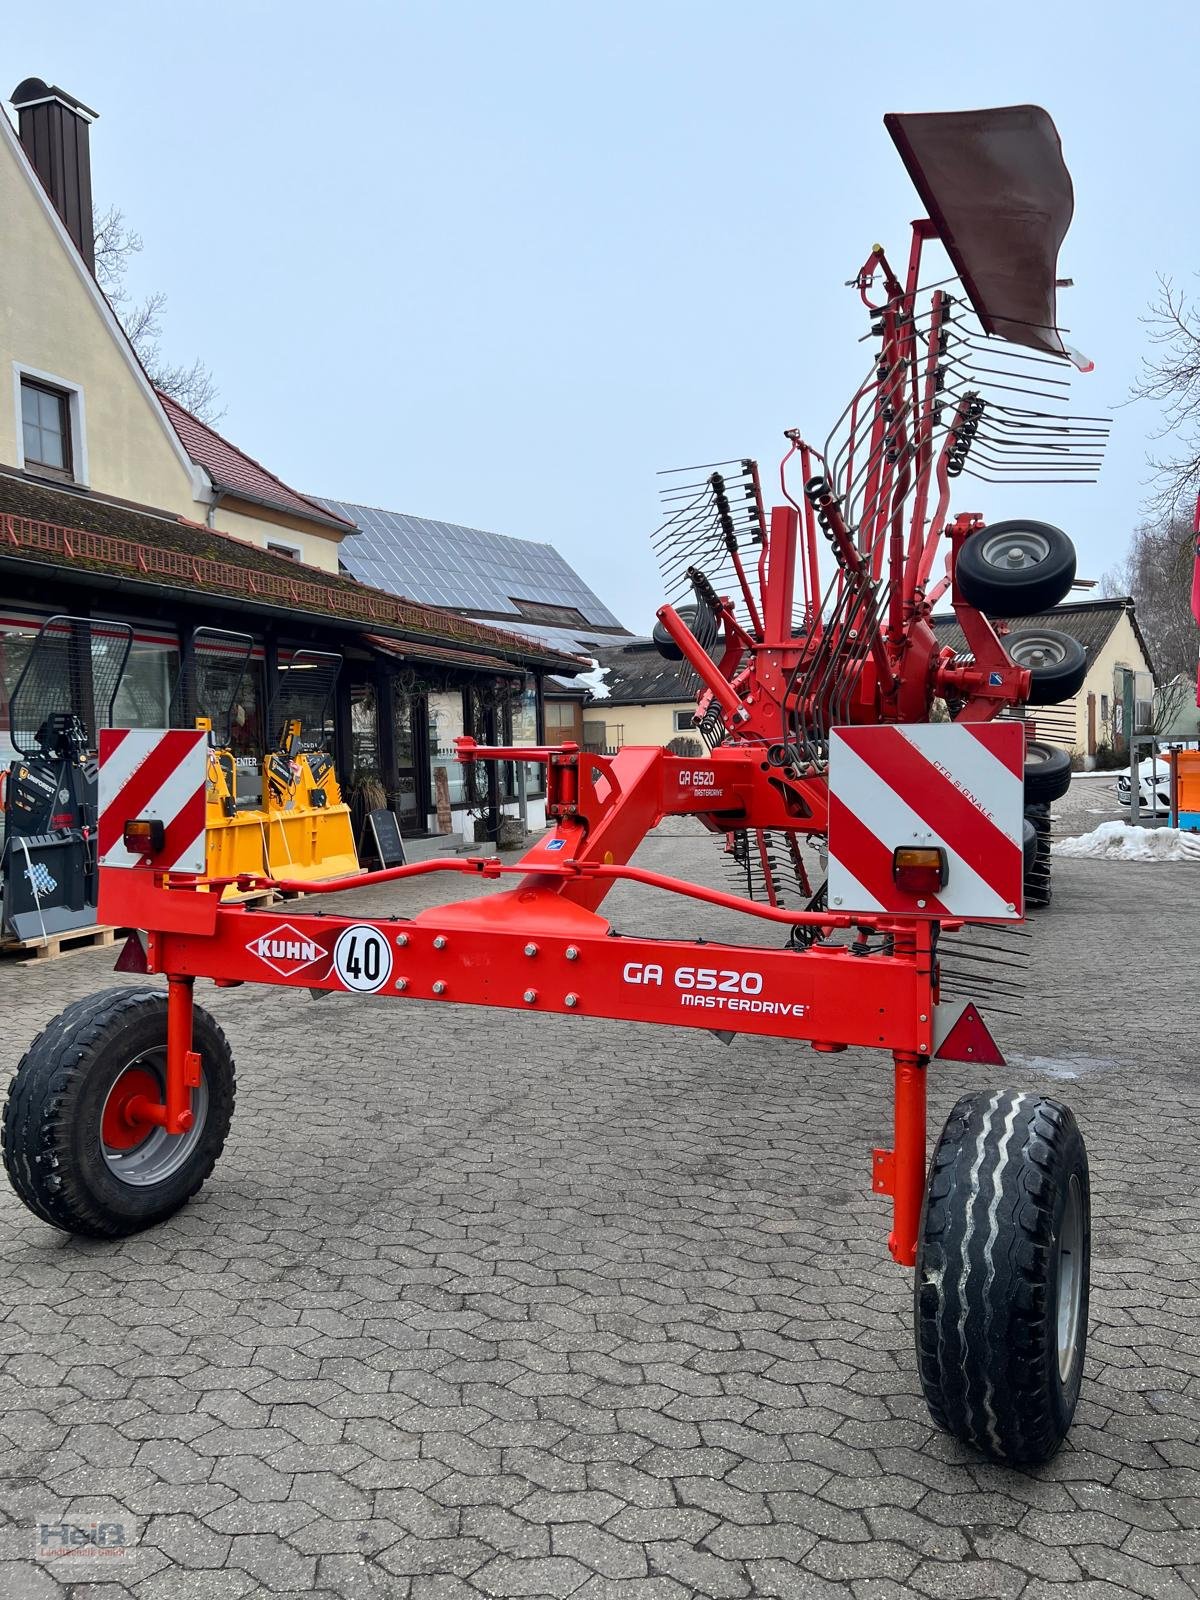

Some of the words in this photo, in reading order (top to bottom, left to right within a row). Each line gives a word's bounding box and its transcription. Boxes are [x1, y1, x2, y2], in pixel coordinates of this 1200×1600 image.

[236, 757, 257, 766] ENTER
[679, 770, 691, 785] GA
[693, 771, 715, 785] 6520
[257, 938, 316, 961] KUHN
[346, 936, 380, 981] 40
[623, 962, 663, 986] GA
[674, 966, 764, 995] 6520
[681, 993, 805, 1017] MASTERDRIVE
